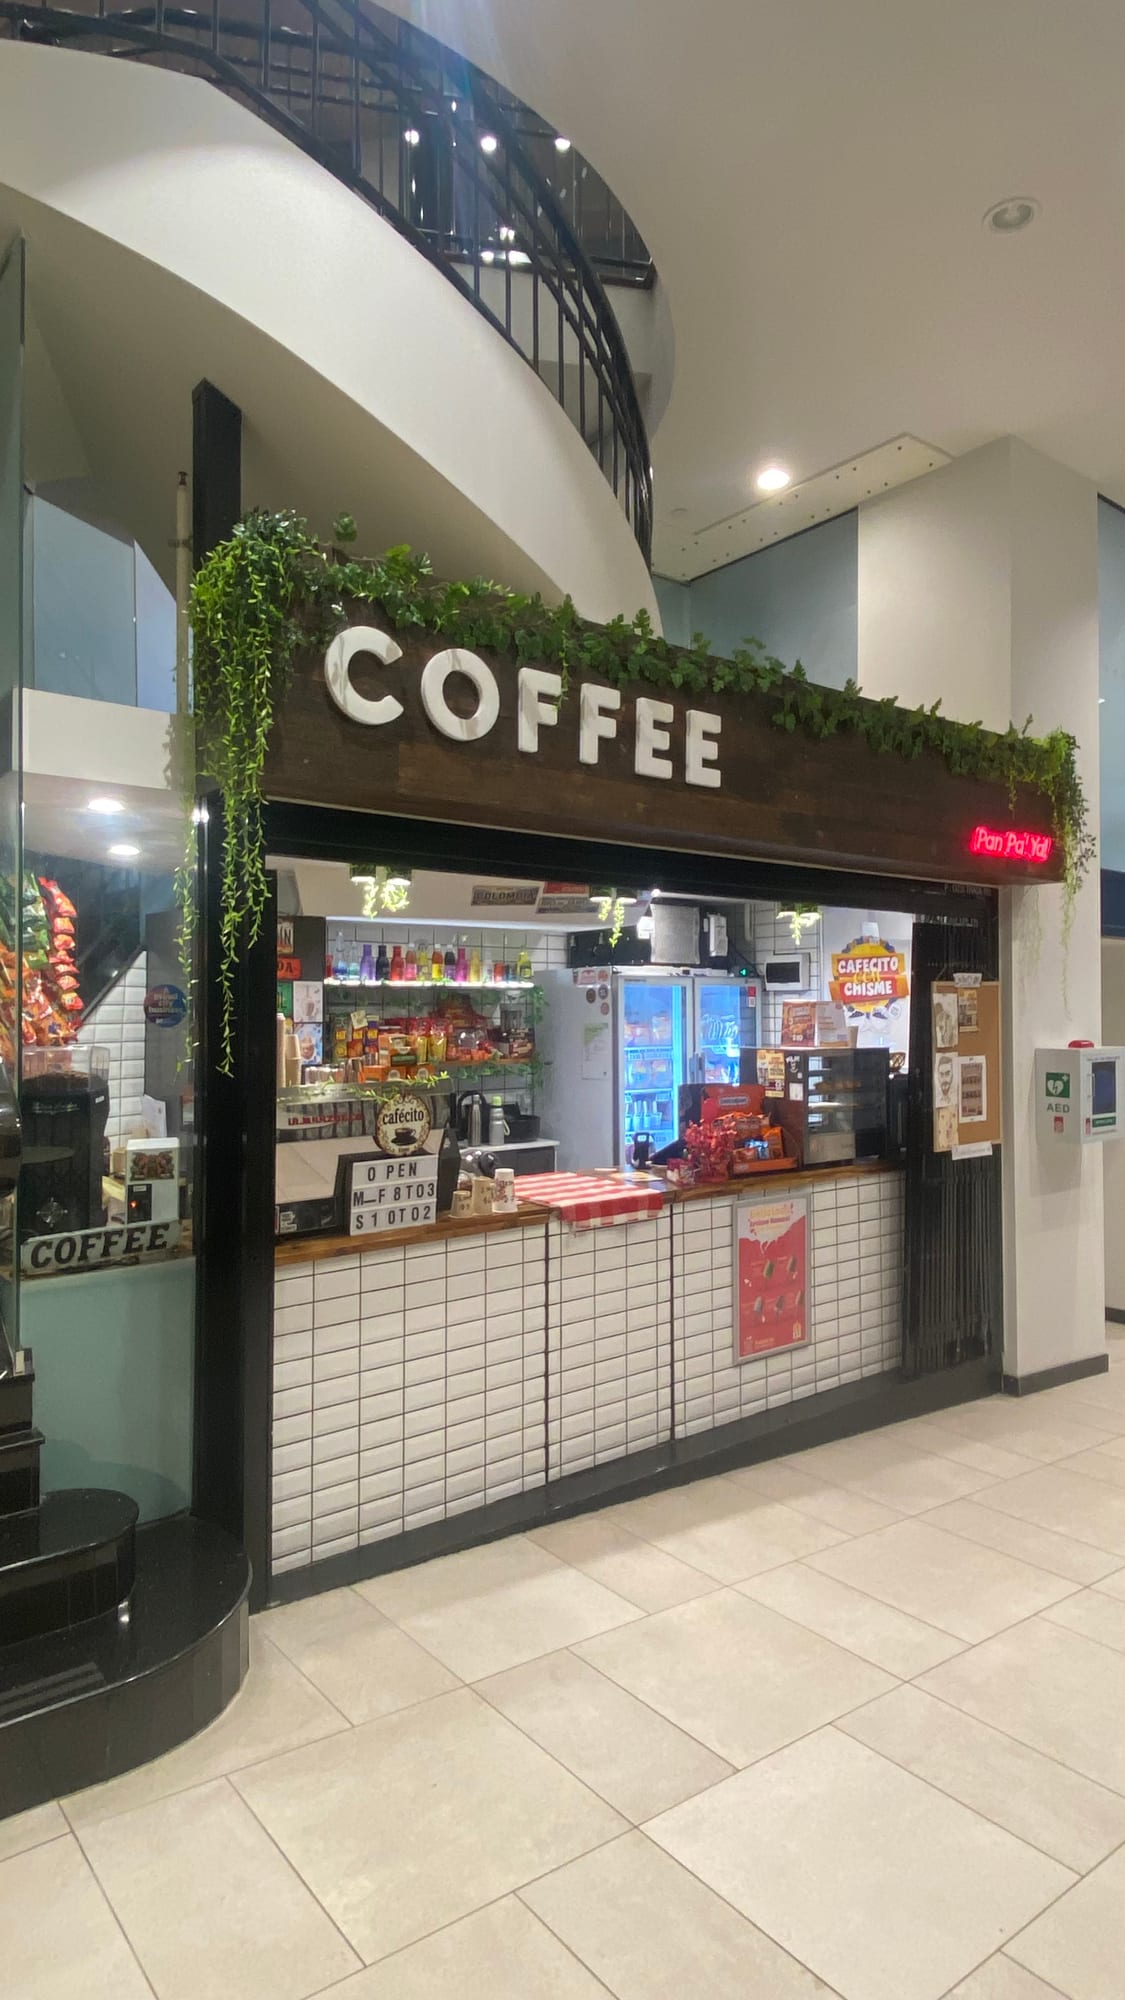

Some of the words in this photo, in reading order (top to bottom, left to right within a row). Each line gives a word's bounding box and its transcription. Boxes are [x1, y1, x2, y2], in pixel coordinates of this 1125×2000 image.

[324, 625, 723, 788] COFFEE
[975, 828, 1003, 852] Pan
[838, 957, 899, 974] CAFECITO
[844, 980, 893, 996] CHISME
[382, 1107, 425, 1125] cafécito
[1046, 1103, 1070, 1113] AED
[30, 1224, 170, 1269] COFFEE
